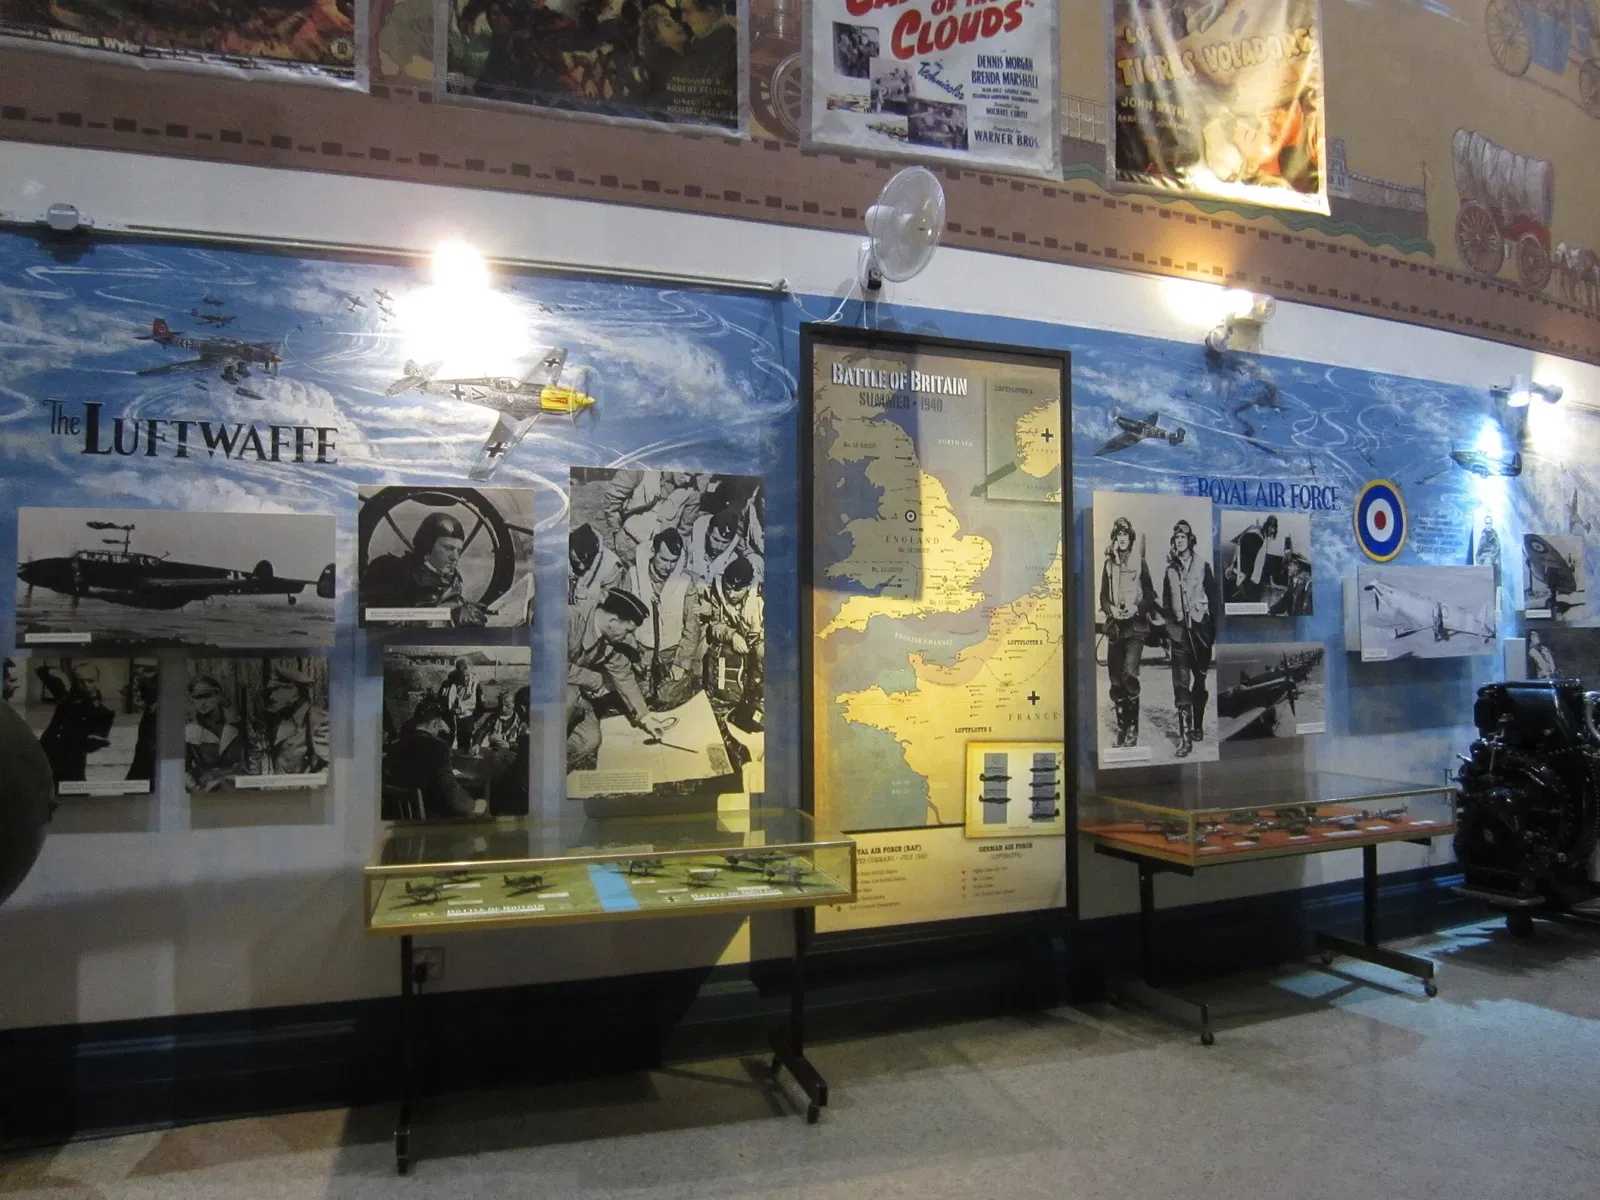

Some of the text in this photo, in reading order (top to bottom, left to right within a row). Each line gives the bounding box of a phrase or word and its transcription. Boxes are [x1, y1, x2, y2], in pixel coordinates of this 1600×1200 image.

[891, 0, 1023, 60] CLOUDS
[977, 54, 1033, 71] DENNIS MORGAN
[666, 83, 697, 93] ROBERT
[971, 70, 1039, 89] BRENDA MARSHALL
[974, 130, 1014, 145] WARNER
[832, 362, 968, 396] BATTLE OF BRITAIN
[858, 391, 943, 413] SUMMER 1940
[43, 399, 339, 465] The LUFTWAFFE
[1198, 477, 1249, 505] ROYAL
[1255, 481, 1287, 507] AIR
[1289, 483, 1341, 511] FORCE
[885, 535, 940, 544] ENGLAND
[1008, 712, 1058, 721] FRANCE
